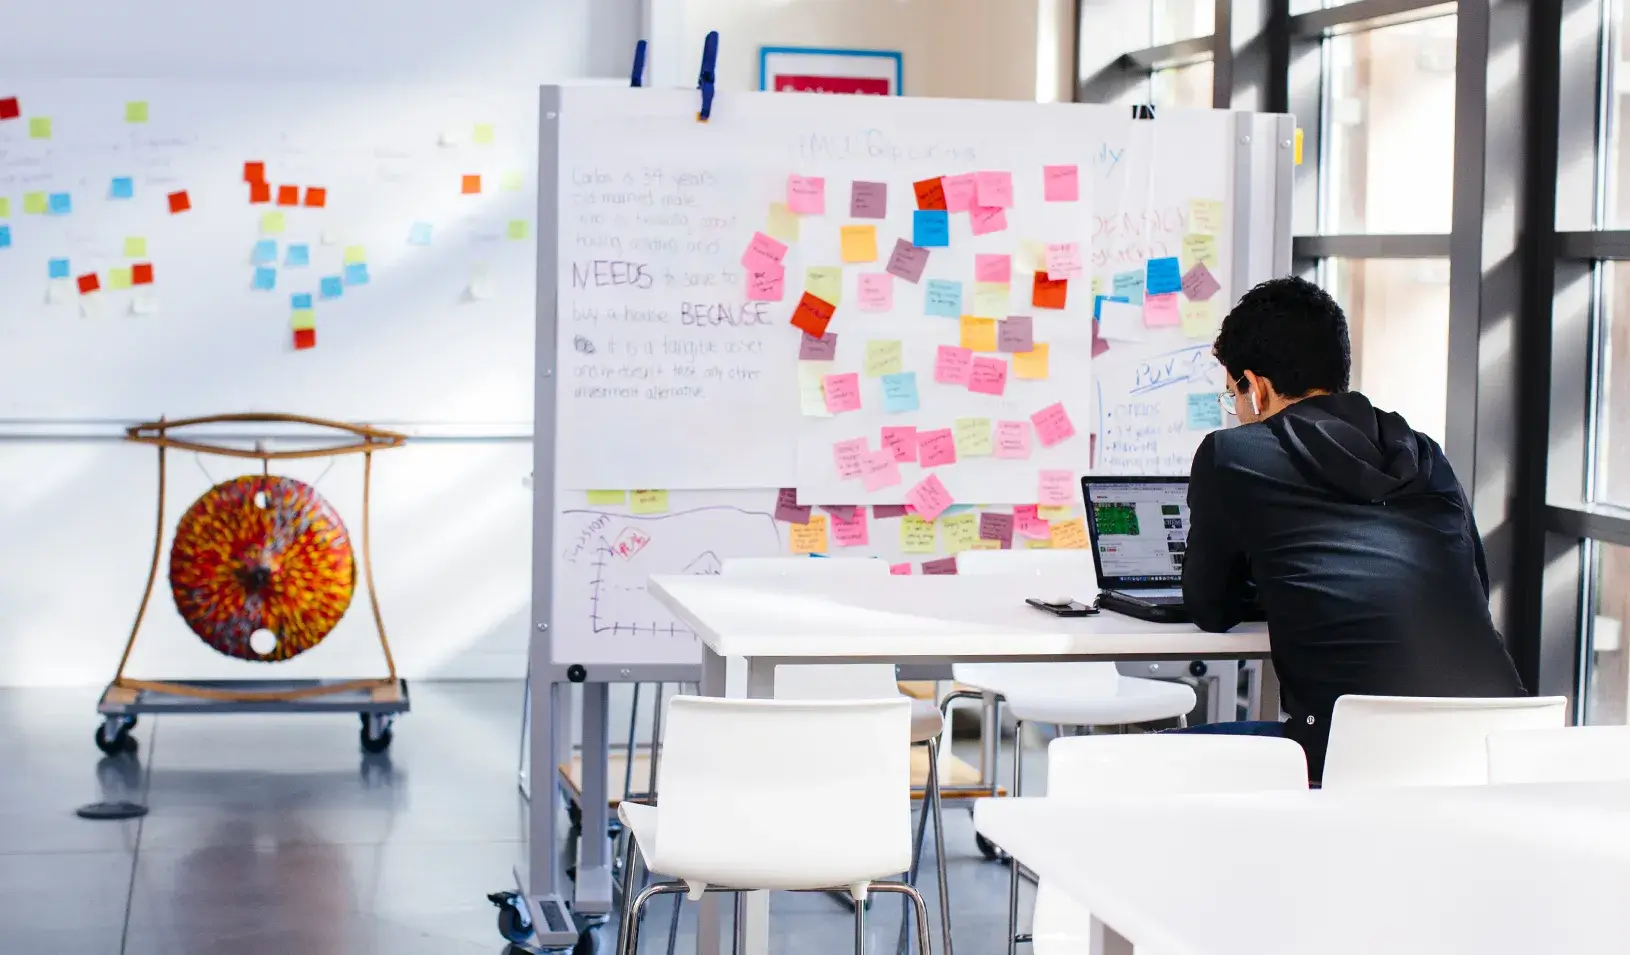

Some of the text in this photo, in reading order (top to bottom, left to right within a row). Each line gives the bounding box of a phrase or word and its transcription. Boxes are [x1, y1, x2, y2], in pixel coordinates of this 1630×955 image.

[572, 260, 653, 289] NEEDS
[572, 298, 599, 328] buy
[624, 302, 670, 323] house
[680, 300, 773, 327] BECAUSE
